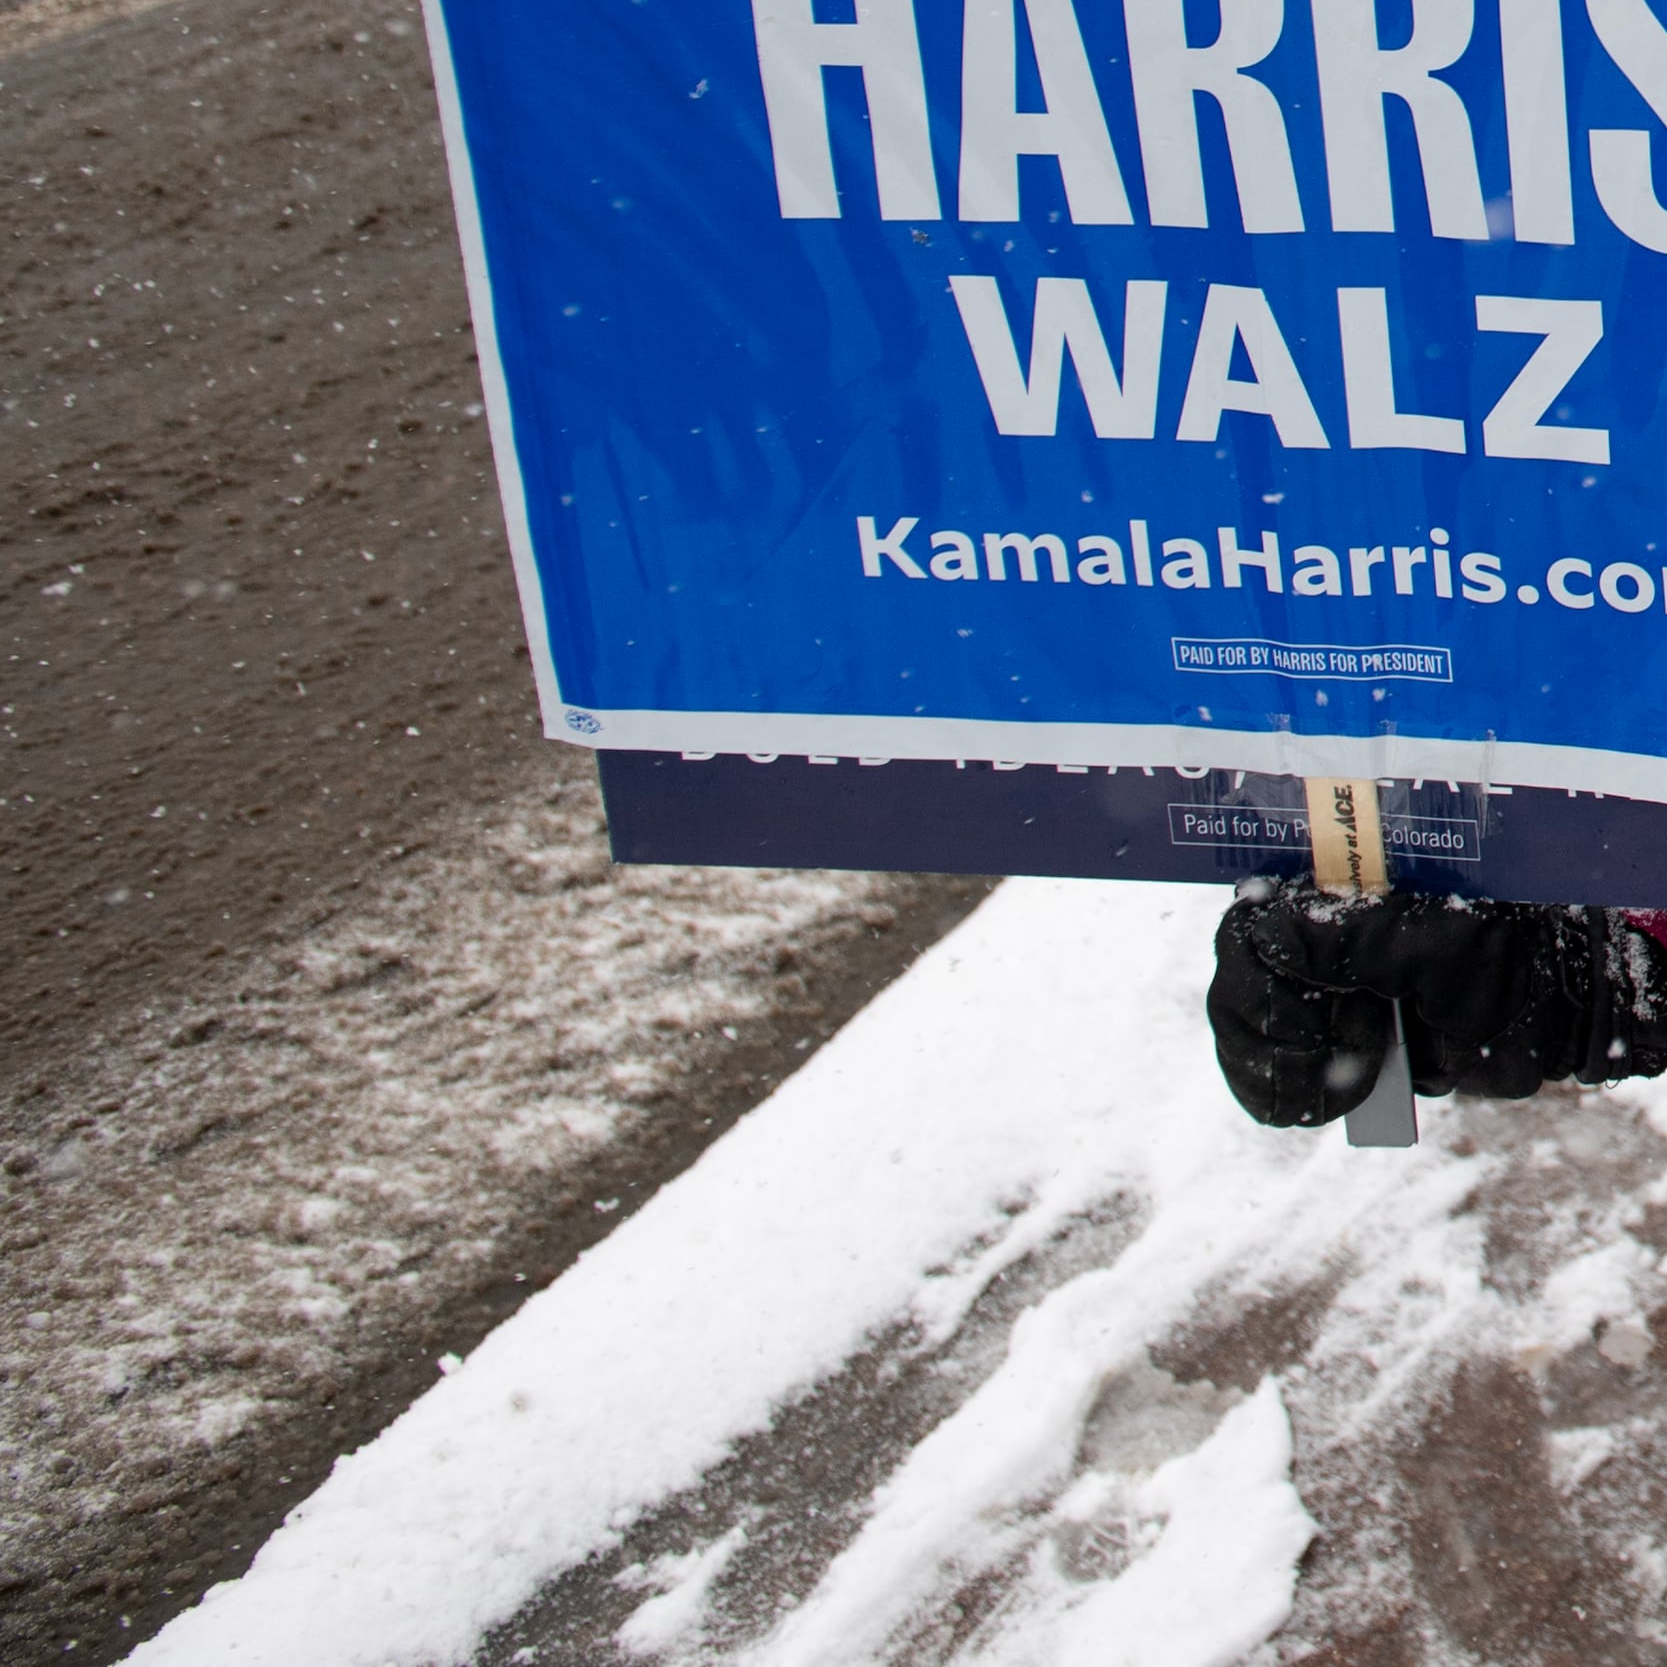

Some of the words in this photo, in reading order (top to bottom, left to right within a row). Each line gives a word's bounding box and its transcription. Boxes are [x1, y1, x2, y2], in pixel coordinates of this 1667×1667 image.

[949, 274, 1610, 464] WALZ
[1181, 645, 1213, 665] PAID
[1217, 646, 1245, 666] FOR
[1248, 647, 1268, 666] BY
[1273, 650, 1326, 671] HARRIS
[1330, 653, 1357, 672] FOR
[1362, 653, 1443, 674] PRESIDENT
[1184, 814, 1226, 836] Paid
[1232, 816, 1260, 837] for
[1266, 817, 1288, 841] by
[1382, 824, 1464, 849] Colorado
[1345, 834, 1358, 848] at
